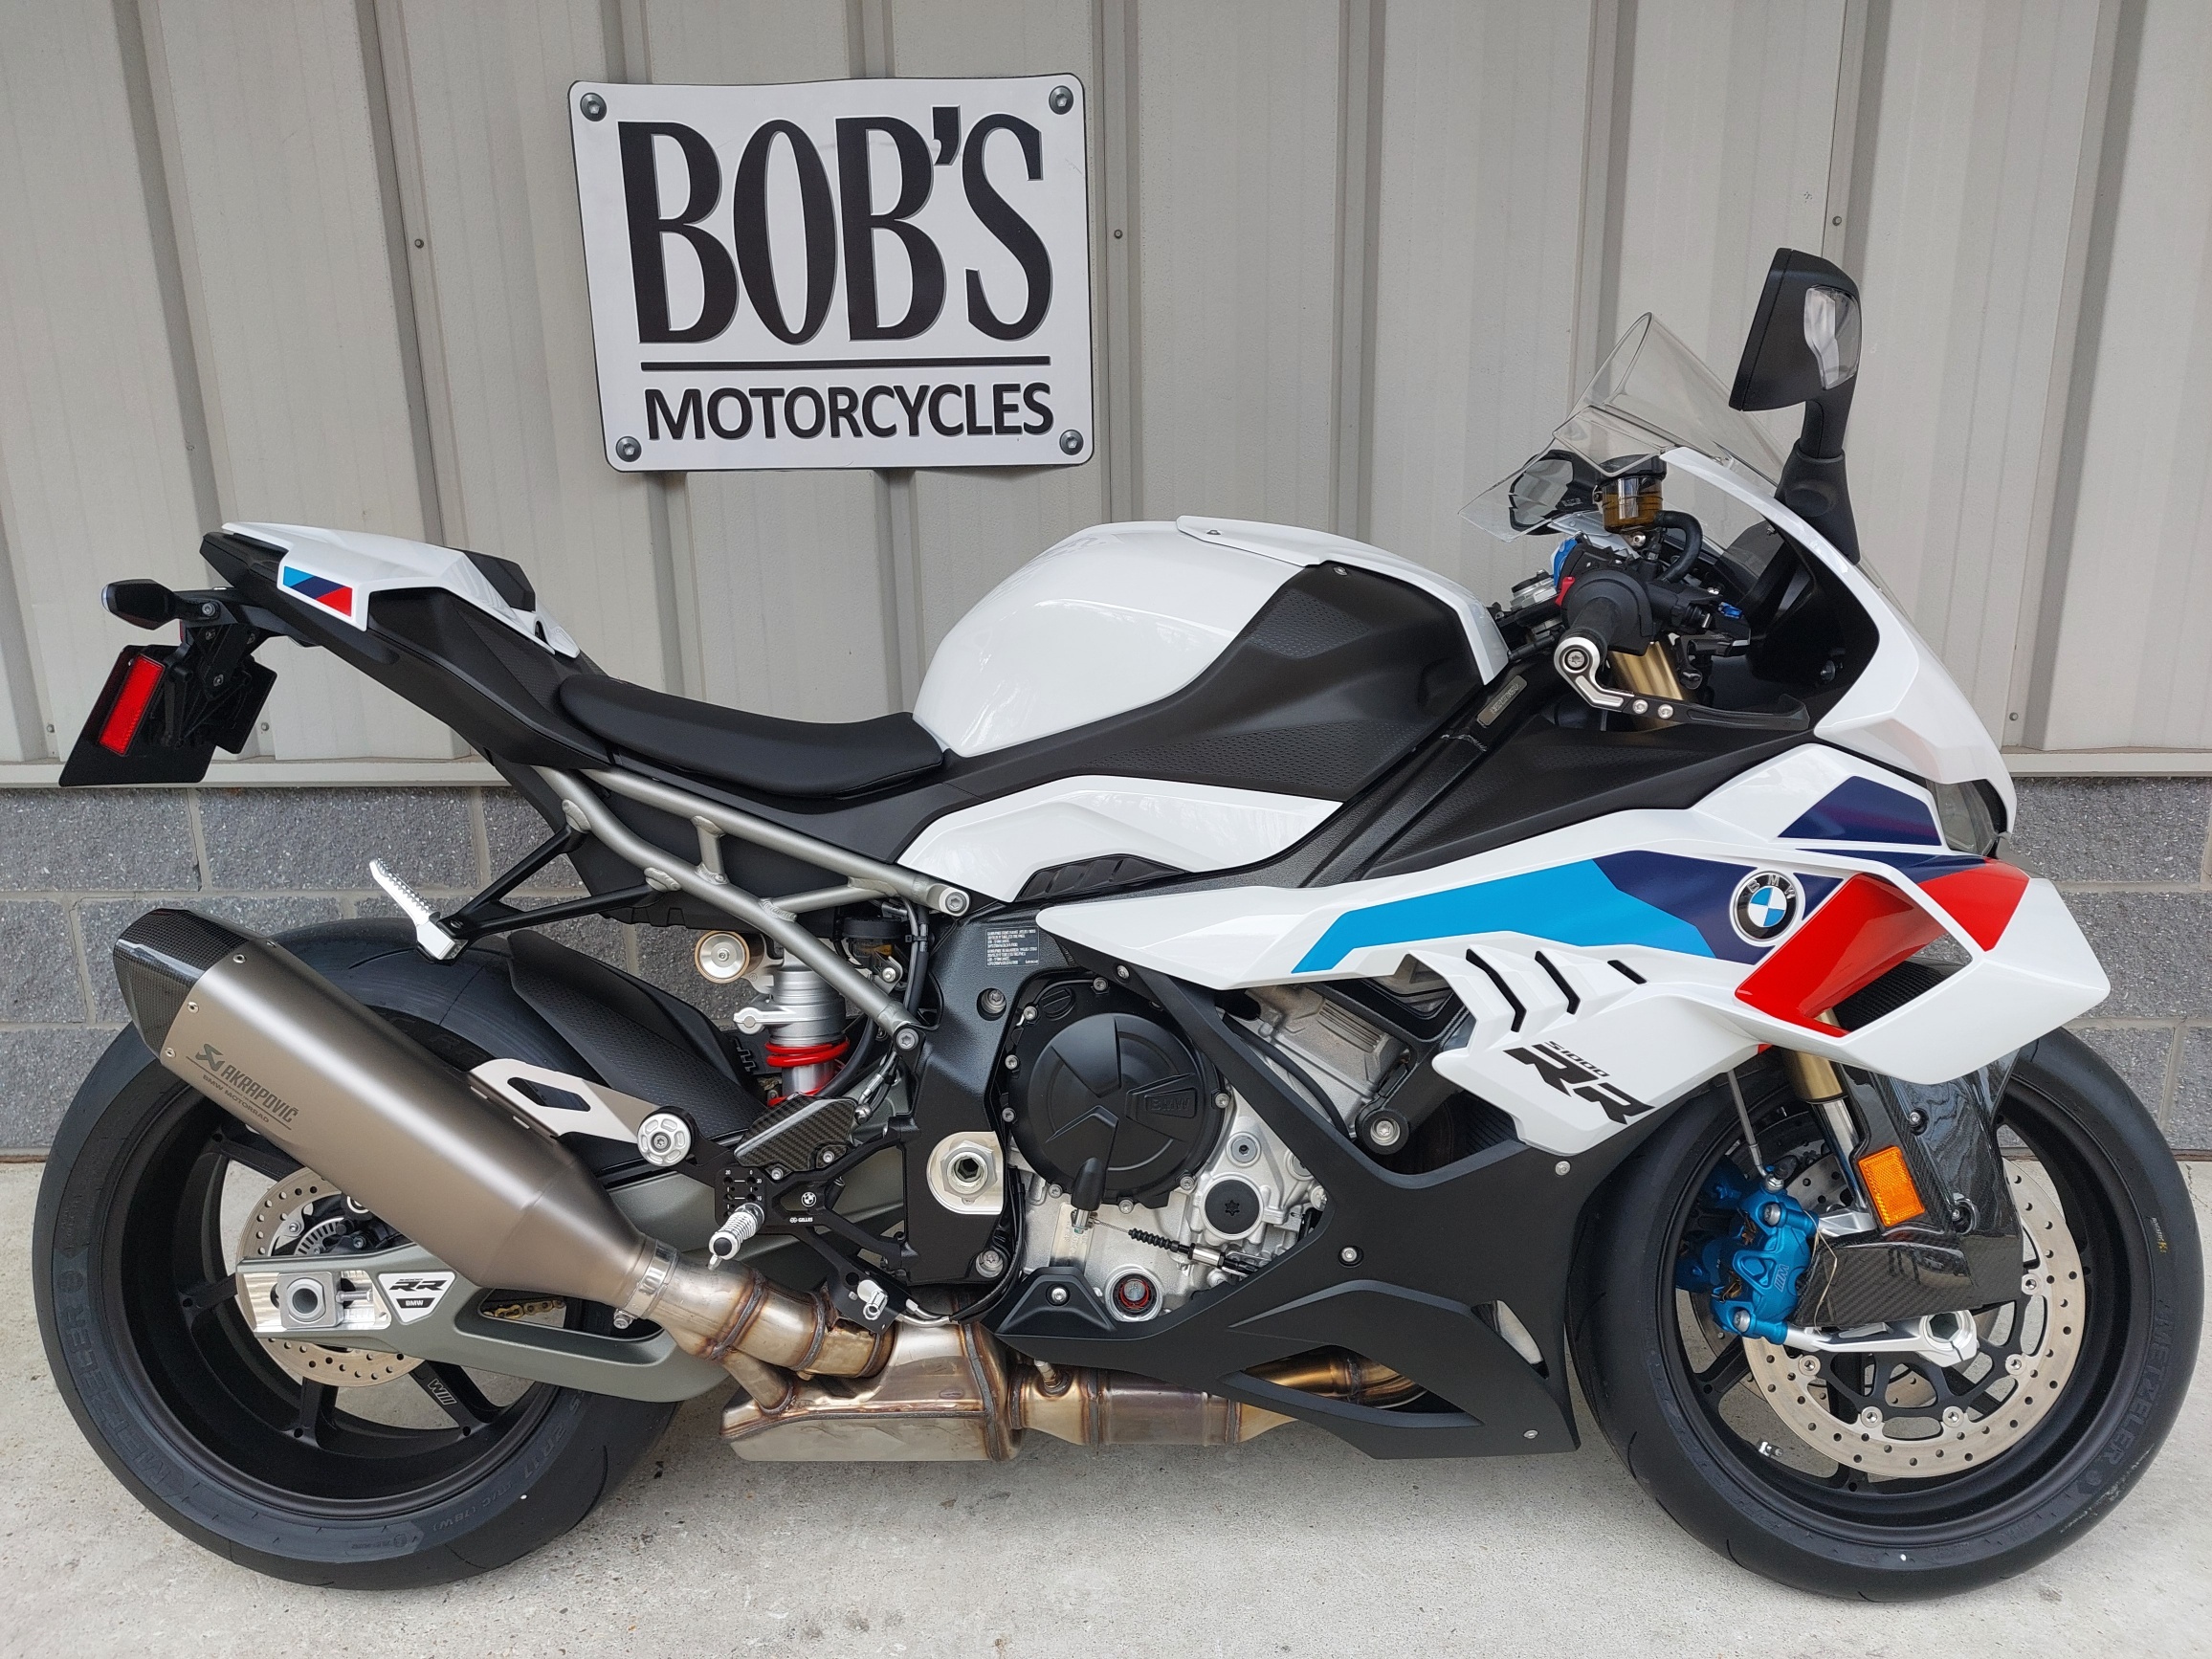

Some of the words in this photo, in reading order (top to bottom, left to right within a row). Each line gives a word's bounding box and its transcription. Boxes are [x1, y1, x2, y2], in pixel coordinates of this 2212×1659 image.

[618, 105, 1053, 344] BOB'S
[644, 382, 1055, 440] MOTORCYCLES
[1747, 874, 1797, 900] BMW
[1503, 1044, 1656, 1125] RR
[1544, 1040, 1610, 1077] S1000
[203, 1074, 224, 1091] BMW
[225, 1090, 270, 1123] MOTORRAD
[59, 1302, 172, 1487] METZELER
[2102, 1316, 2176, 1467] METZELER
